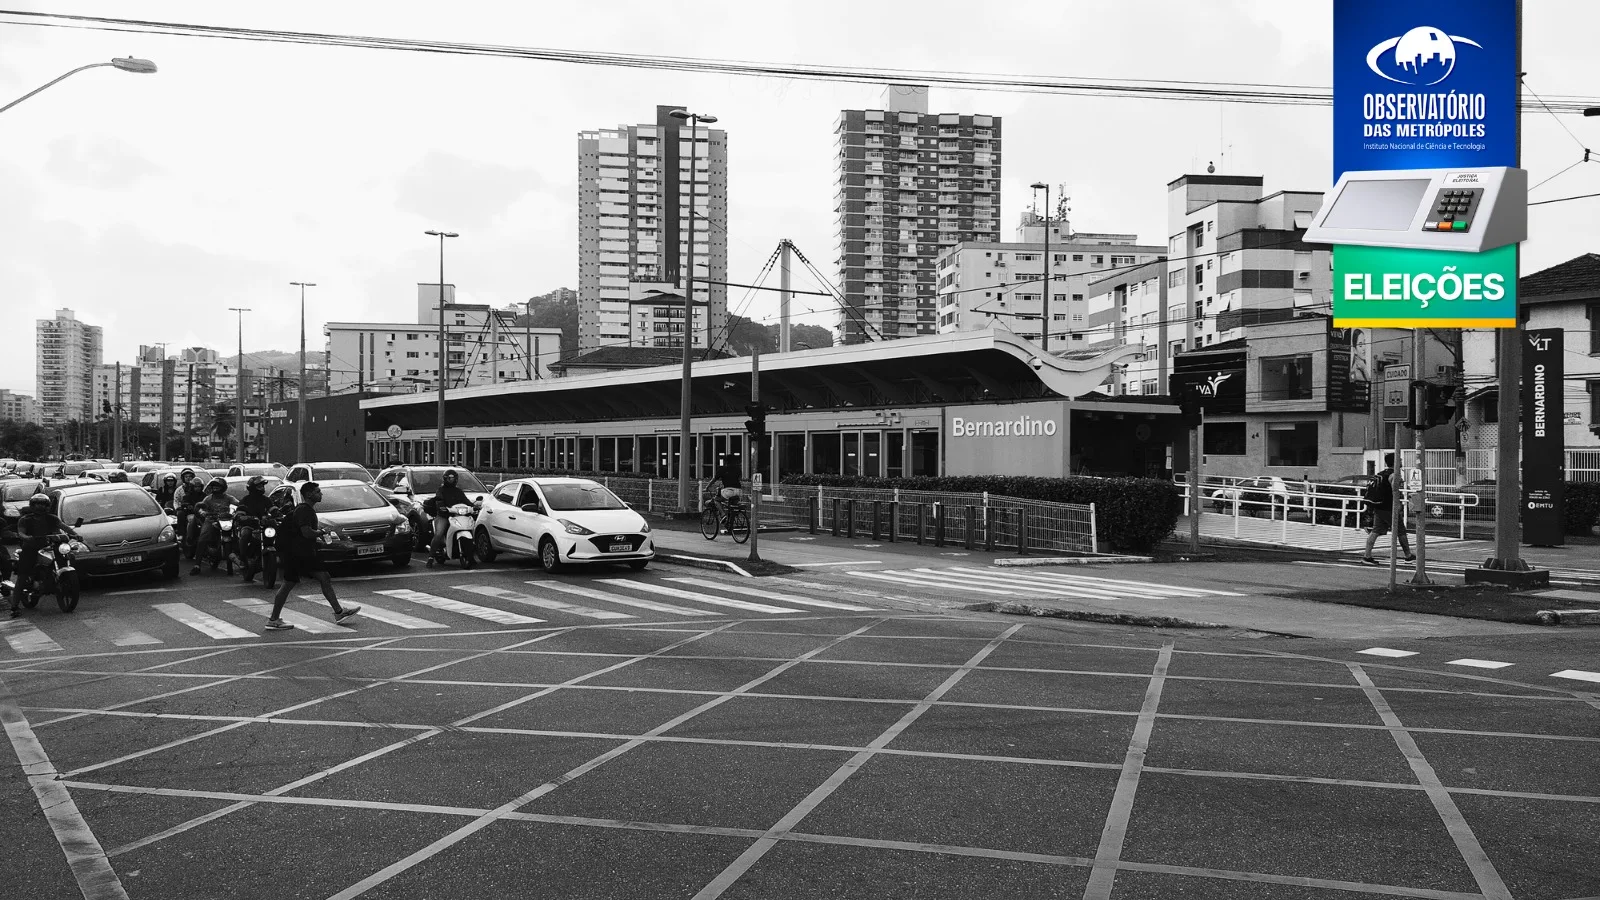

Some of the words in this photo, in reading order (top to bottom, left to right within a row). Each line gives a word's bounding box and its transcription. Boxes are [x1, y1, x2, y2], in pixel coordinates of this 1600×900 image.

[1528, 334, 1553, 351] VLT
[1386, 368, 1408, 379] CUIDADO
[1534, 364, 1546, 437] BERNARDINO
[953, 415, 1057, 437] Bernardino
